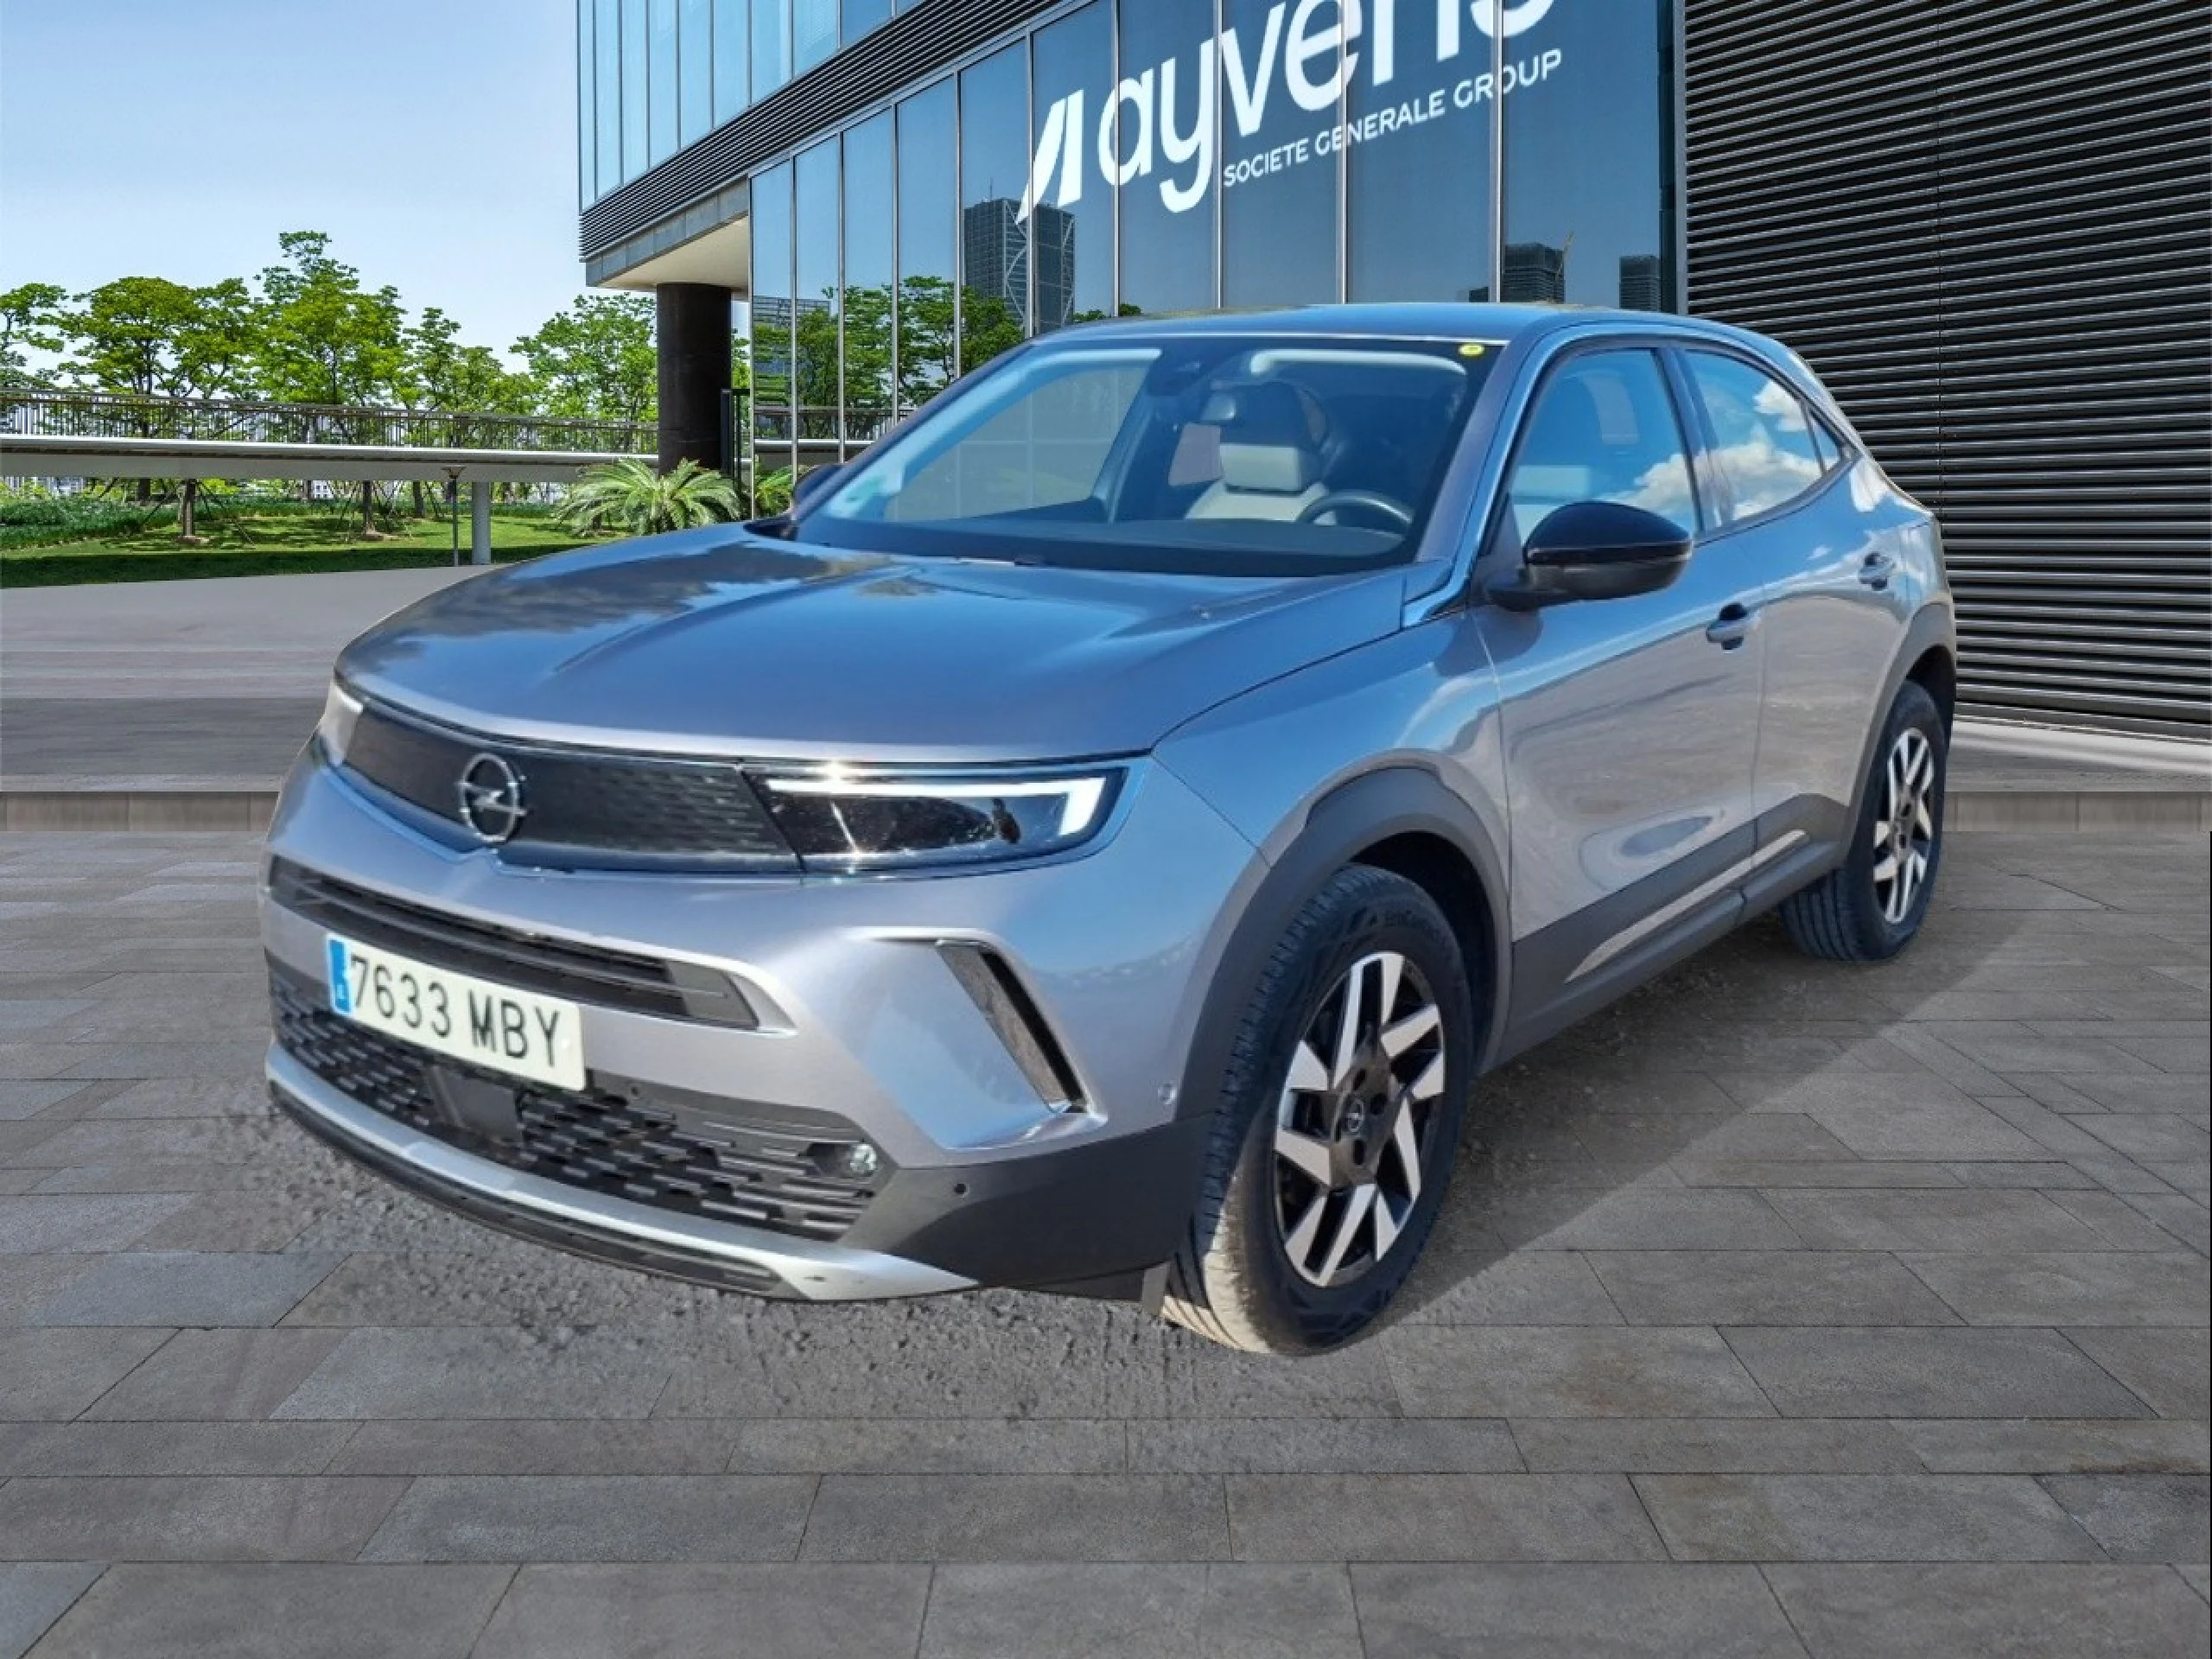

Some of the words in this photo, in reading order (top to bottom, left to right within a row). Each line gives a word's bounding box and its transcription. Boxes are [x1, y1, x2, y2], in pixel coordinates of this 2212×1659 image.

[1097, 0, 1554, 213] ayven
[1223, 137, 1309, 188] SOCIETE
[1314, 89, 1446, 156] GENERALE
[1452, 48, 1561, 109] GROUP
[350, 953, 451, 1039] 7633
[467, 988, 561, 1069] MBY
